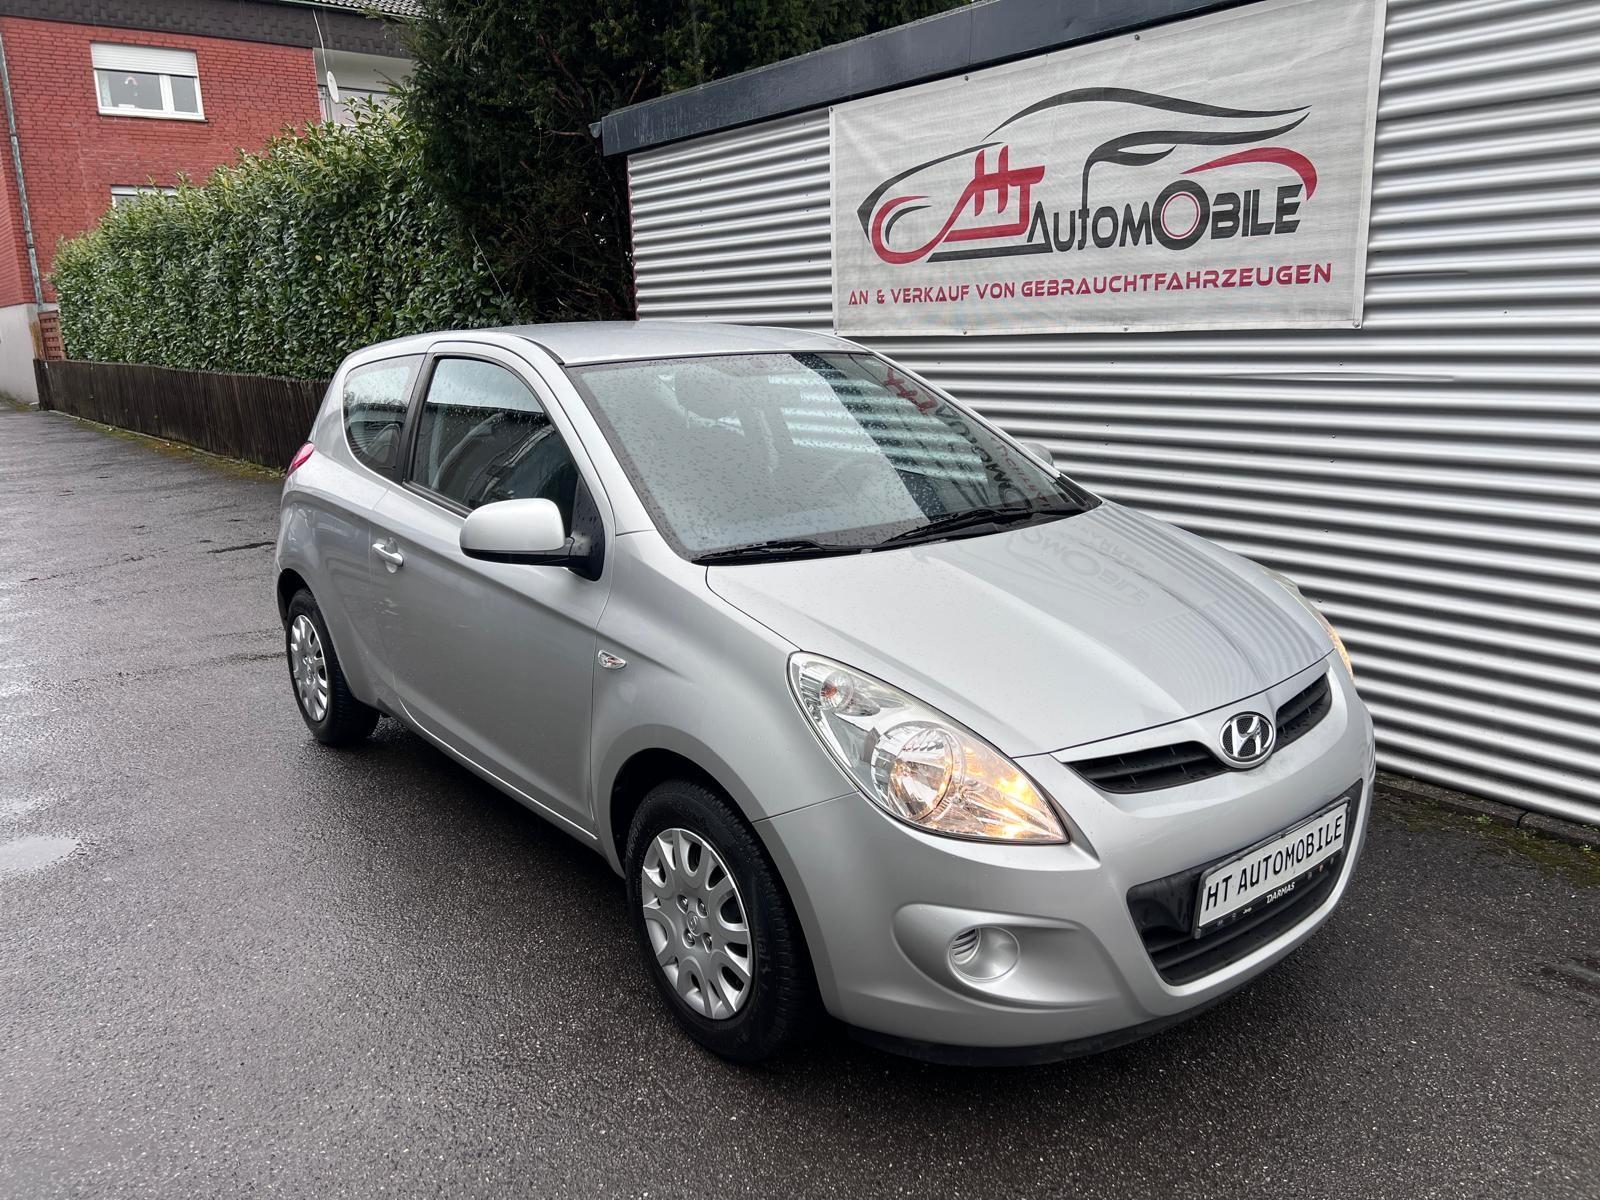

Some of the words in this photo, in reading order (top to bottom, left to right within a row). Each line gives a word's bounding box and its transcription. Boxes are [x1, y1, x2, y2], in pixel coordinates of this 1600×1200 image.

[1026, 180, 1304, 253] AUTOMOBILE
[848, 289, 869, 305] AN
[876, 288, 886, 304] &
[890, 284, 970, 304] VERKAUF
[975, 281, 1015, 300] VON
[1021, 262, 1332, 298] GEBRAUCHTFAHRZEUGEN
[1205, 874, 1233, 912] HT
[1237, 815, 1343, 895] AUTOMOBILE
[1266, 881, 1296, 904] DARMAS
